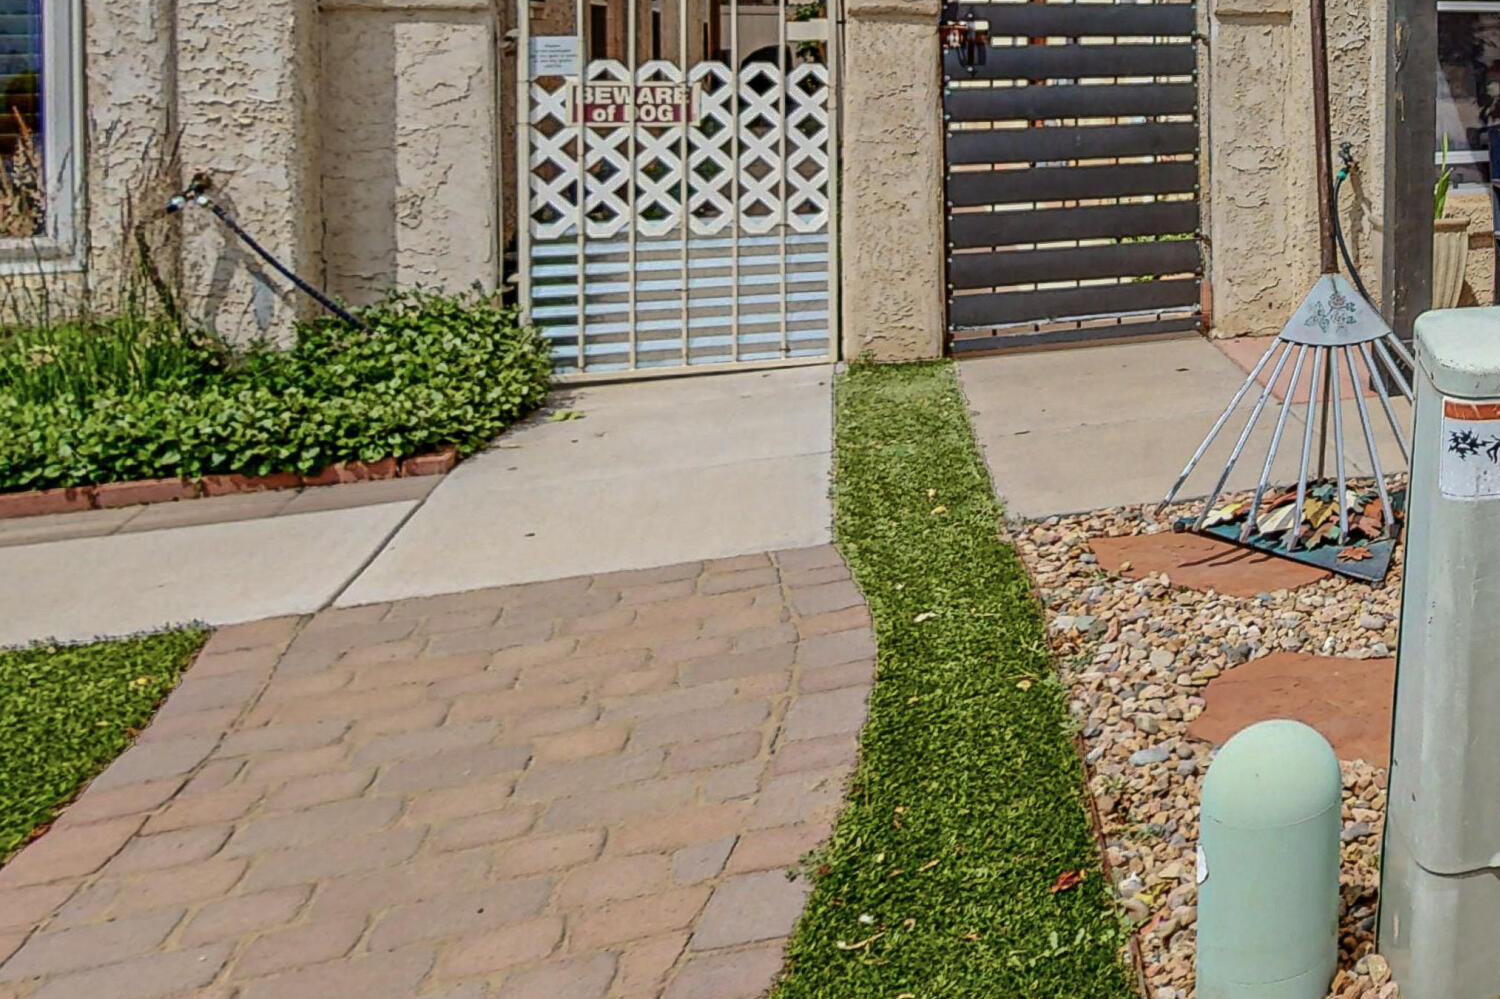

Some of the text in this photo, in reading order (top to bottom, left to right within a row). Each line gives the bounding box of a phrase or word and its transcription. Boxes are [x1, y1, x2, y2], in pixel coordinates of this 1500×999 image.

[576, 86, 689, 105] BEWARE
[592, 104, 674, 122] of DOG
